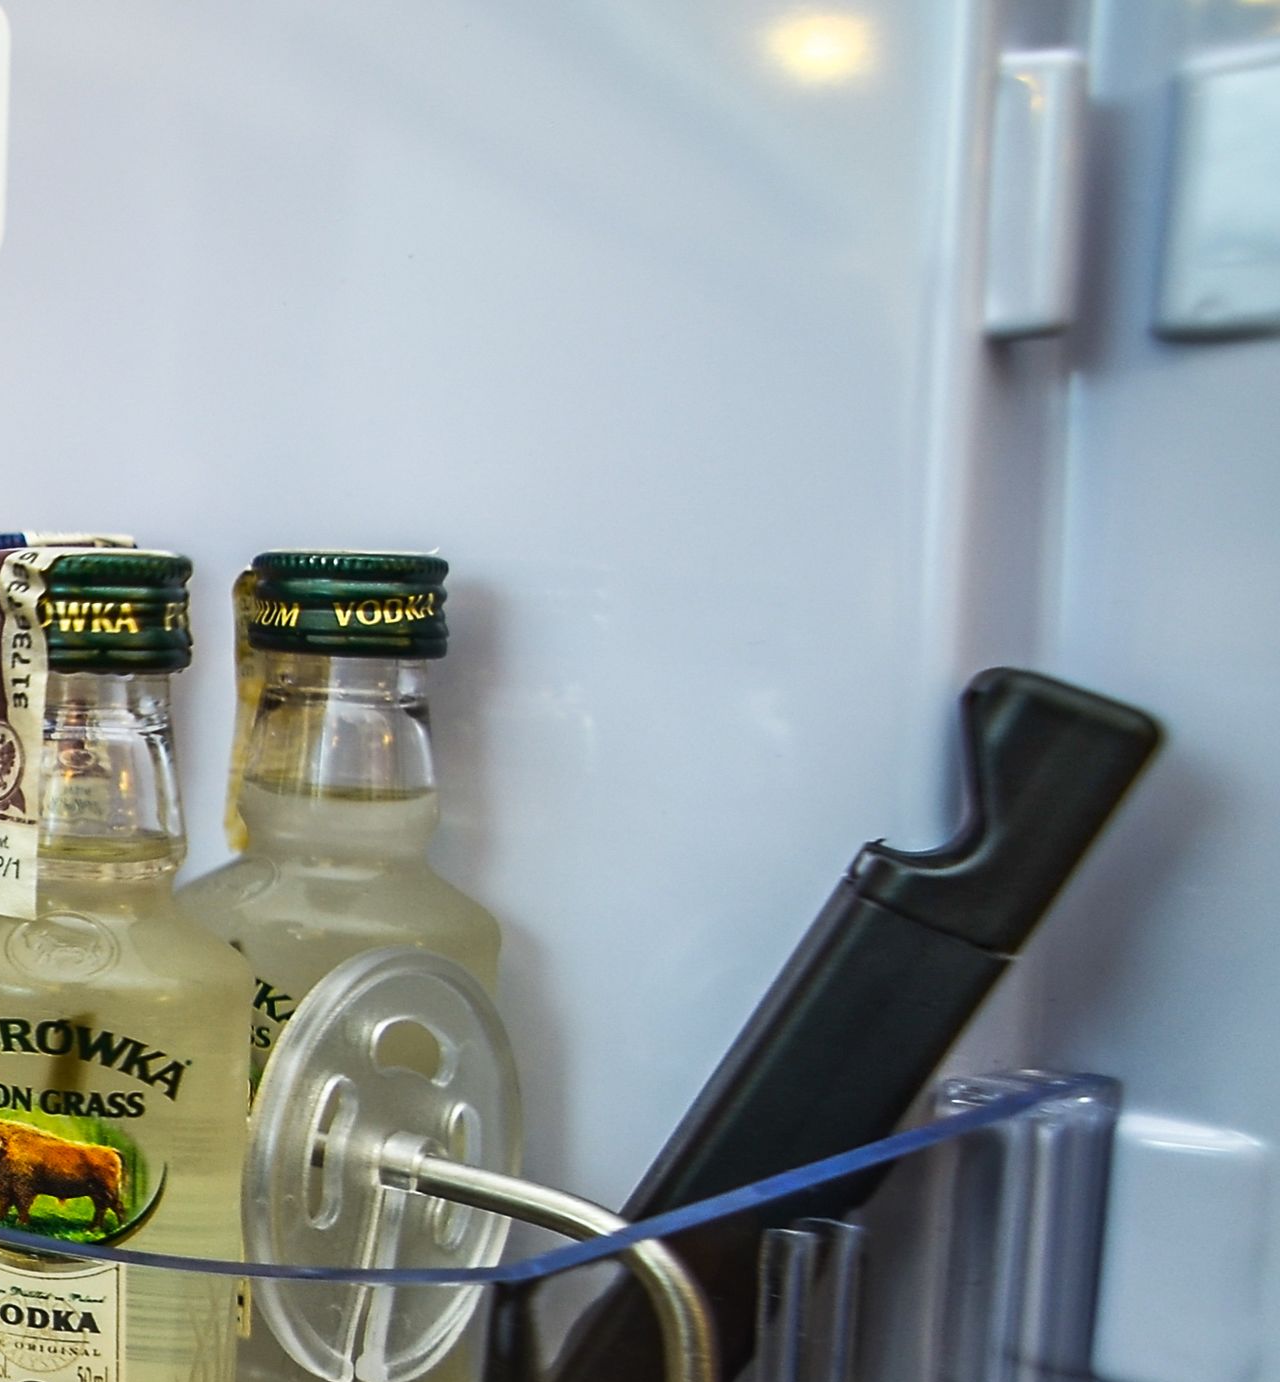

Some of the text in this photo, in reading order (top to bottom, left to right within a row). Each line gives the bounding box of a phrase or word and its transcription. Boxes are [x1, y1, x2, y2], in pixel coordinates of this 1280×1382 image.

[333, 593, 435, 628] VODKA
[40, 1088, 146, 1119] GRASS
[14, 1341, 102, 1358] ORIGINAL
